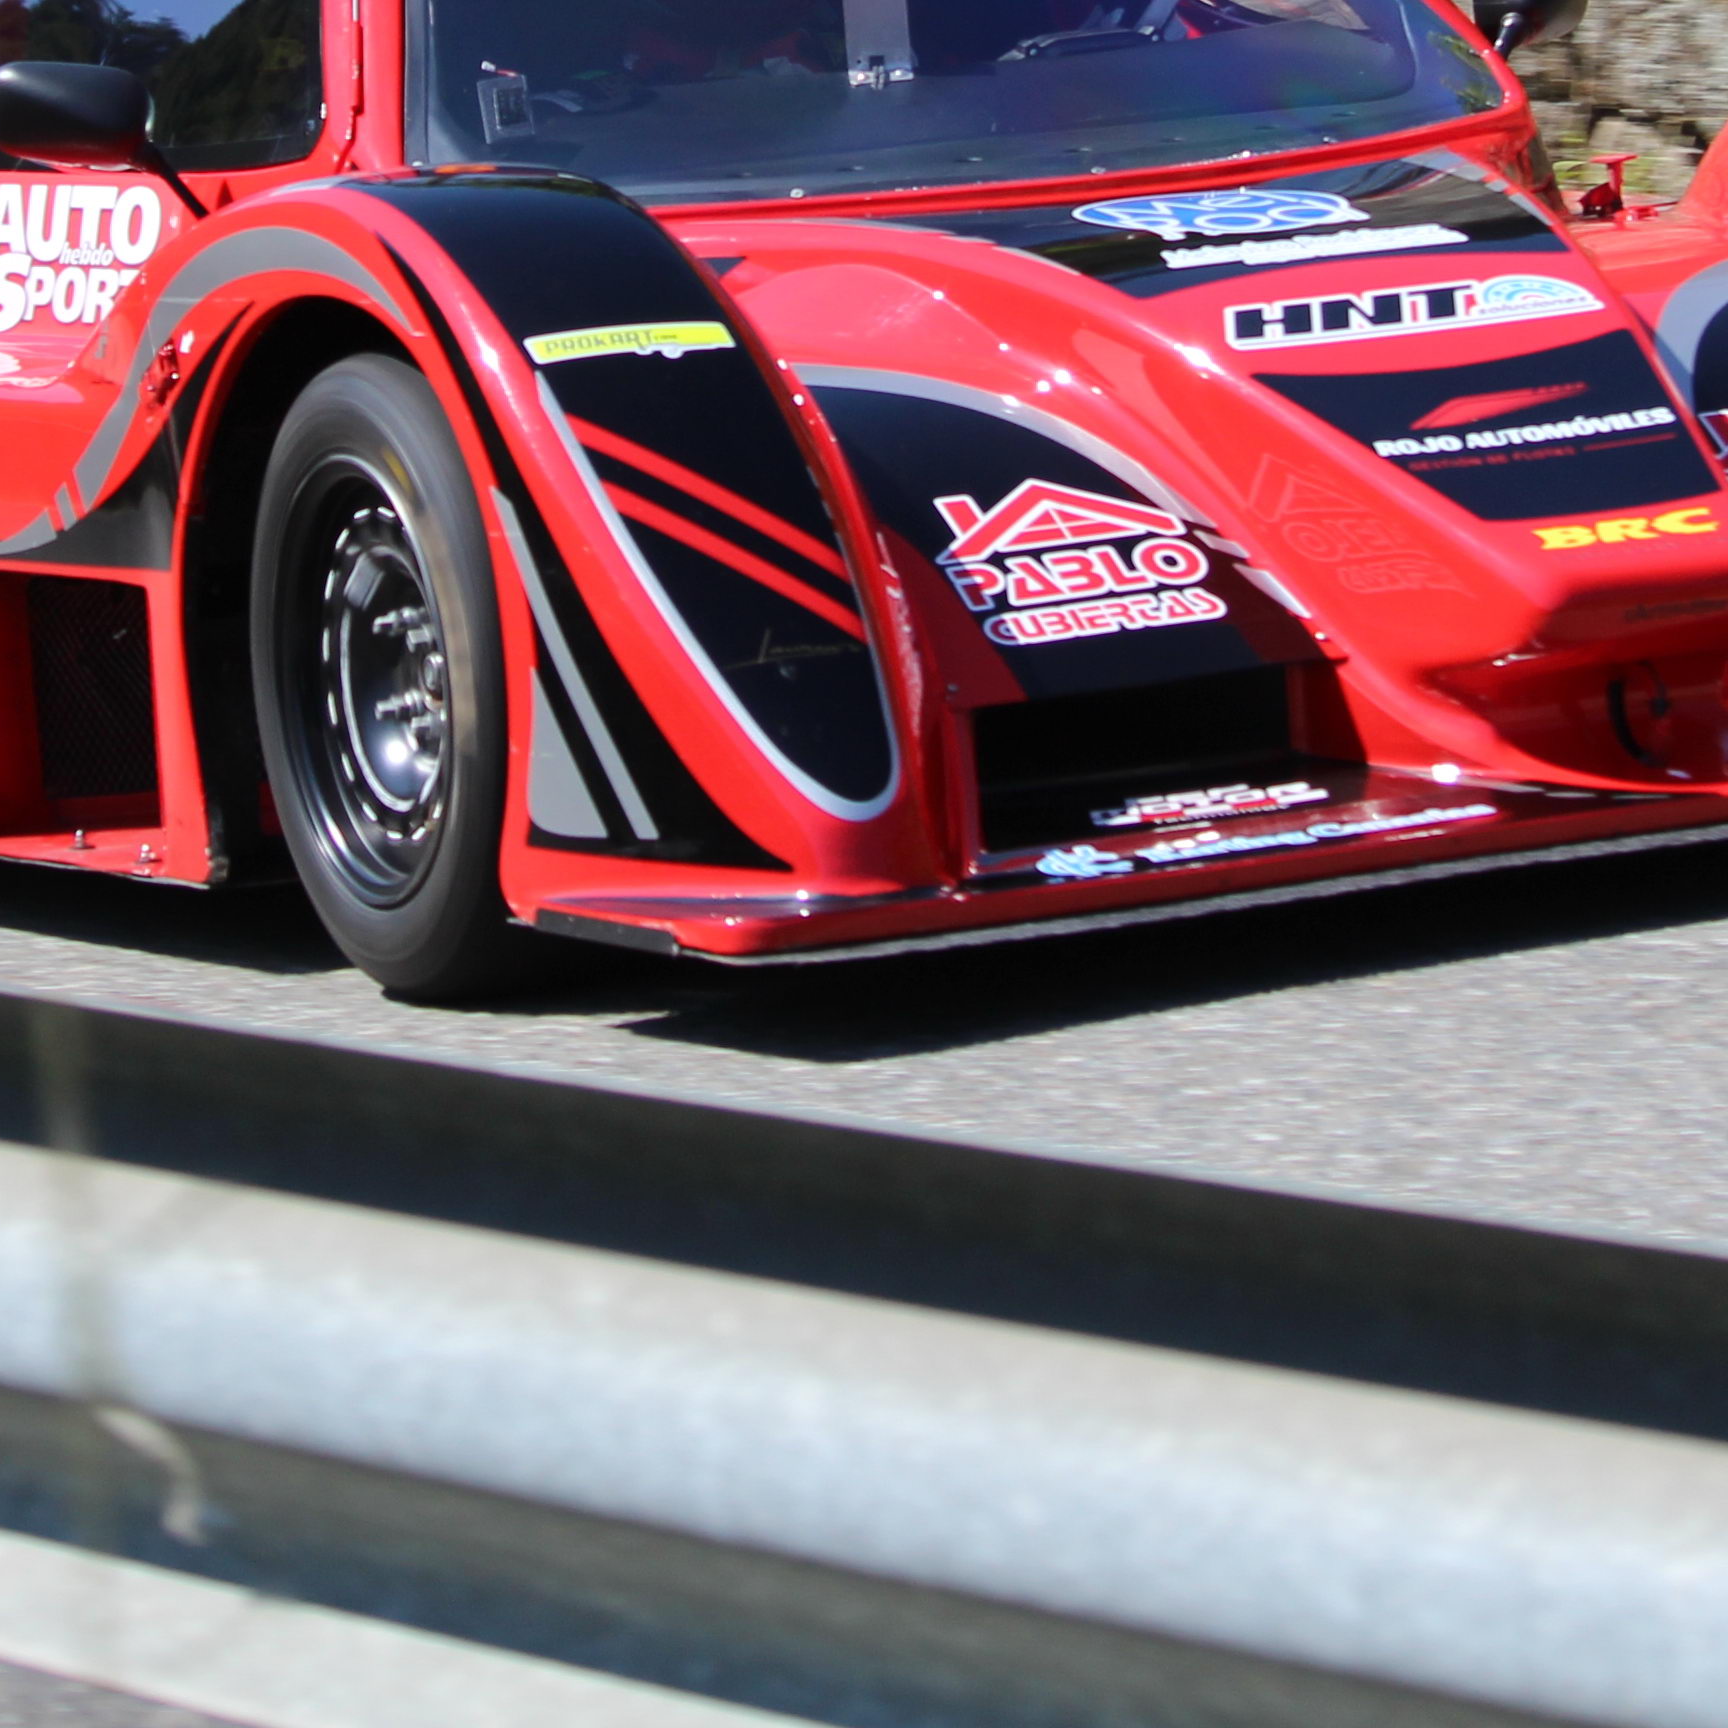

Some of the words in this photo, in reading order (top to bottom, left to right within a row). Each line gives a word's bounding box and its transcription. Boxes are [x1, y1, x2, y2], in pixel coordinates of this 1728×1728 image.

[59, 241, 114, 266] hebdo
[1235, 285, 1472, 339] HNT
[1373, 435, 1463, 458] ROJO
[1466, 406, 1676, 449] AUTOMÓVILES
[1532, 507, 1720, 550] BRC
[946, 537, 1209, 611] PABLO
[983, 588, 1228, 645] CUBIERTAS
